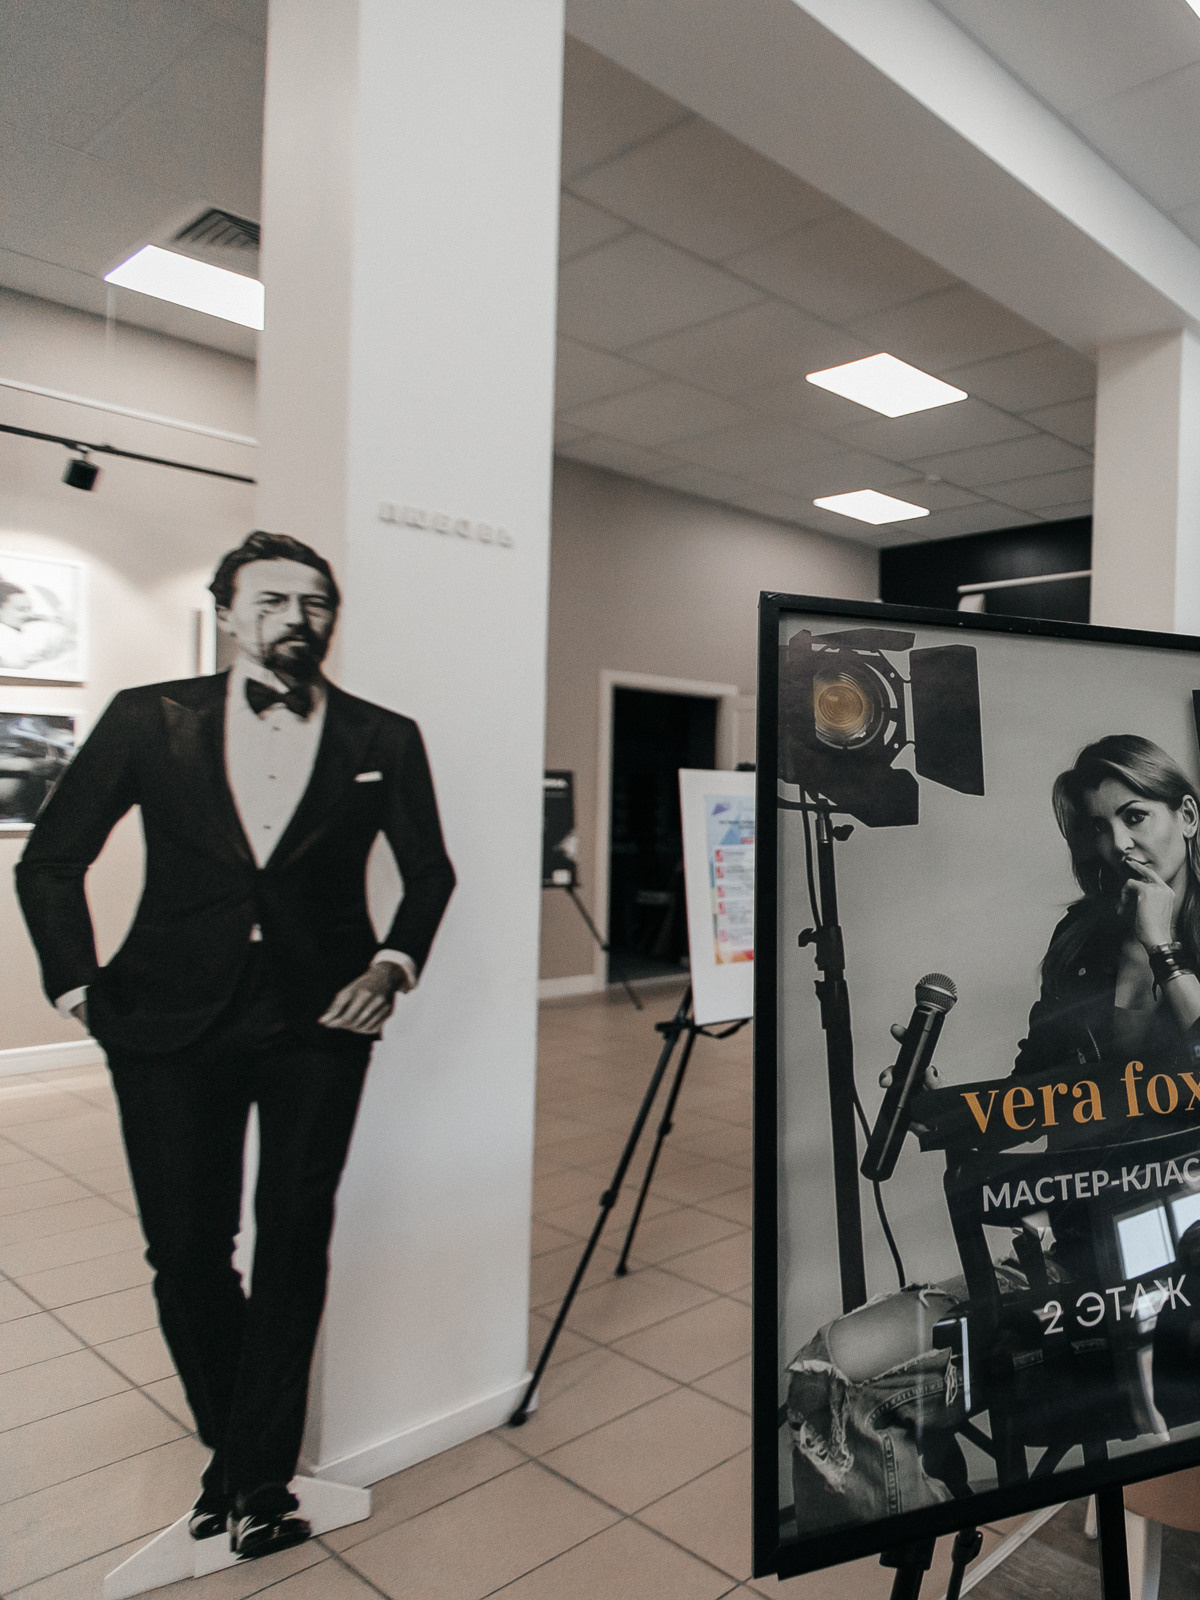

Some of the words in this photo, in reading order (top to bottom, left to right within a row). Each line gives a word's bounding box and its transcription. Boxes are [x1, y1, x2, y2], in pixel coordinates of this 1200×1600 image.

[960, 1079, 1106, 1133] vera
[1043, 1300, 1064, 1336] 2
[1075, 1274, 1192, 1328] ЭТАЖ
